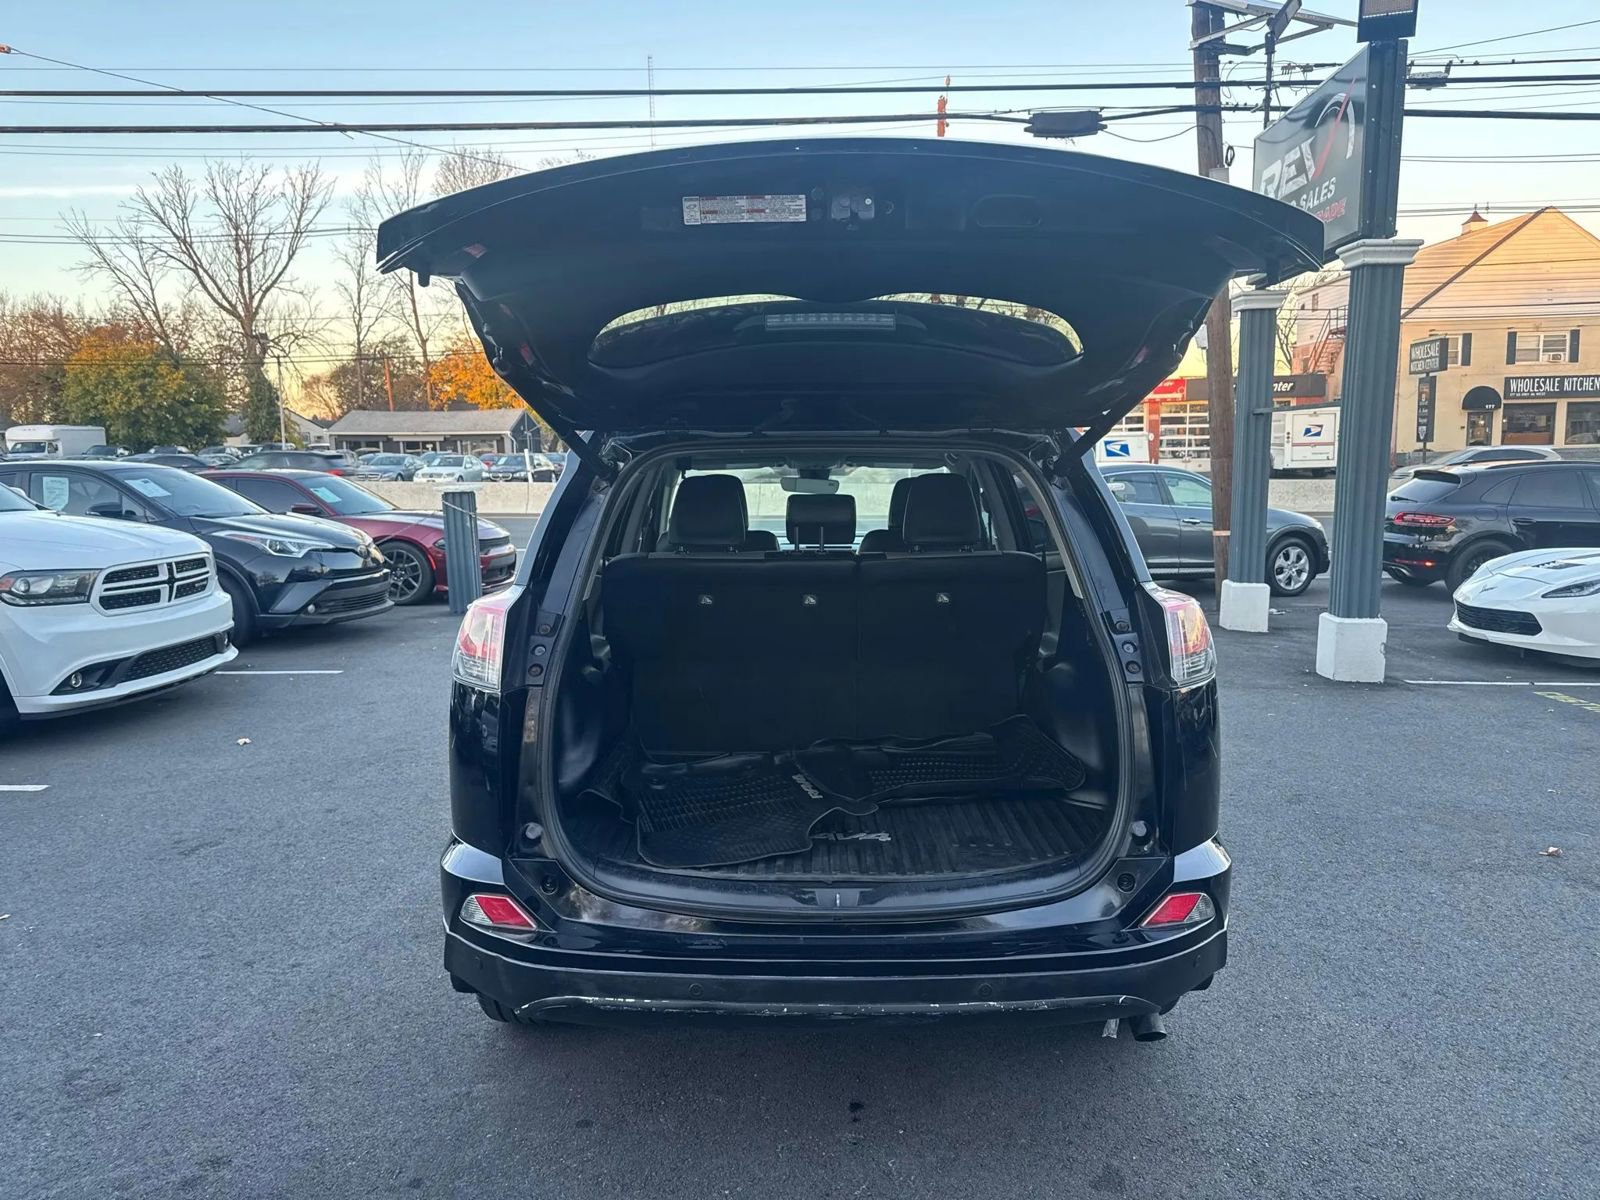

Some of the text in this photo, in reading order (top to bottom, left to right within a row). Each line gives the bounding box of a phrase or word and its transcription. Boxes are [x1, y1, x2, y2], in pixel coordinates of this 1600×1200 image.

[1300, 177, 1336, 211] SALES
[1411, 341, 1440, 360] WHOLESALE
[1510, 376, 1600, 392] WHOLESALE KITCHEN
